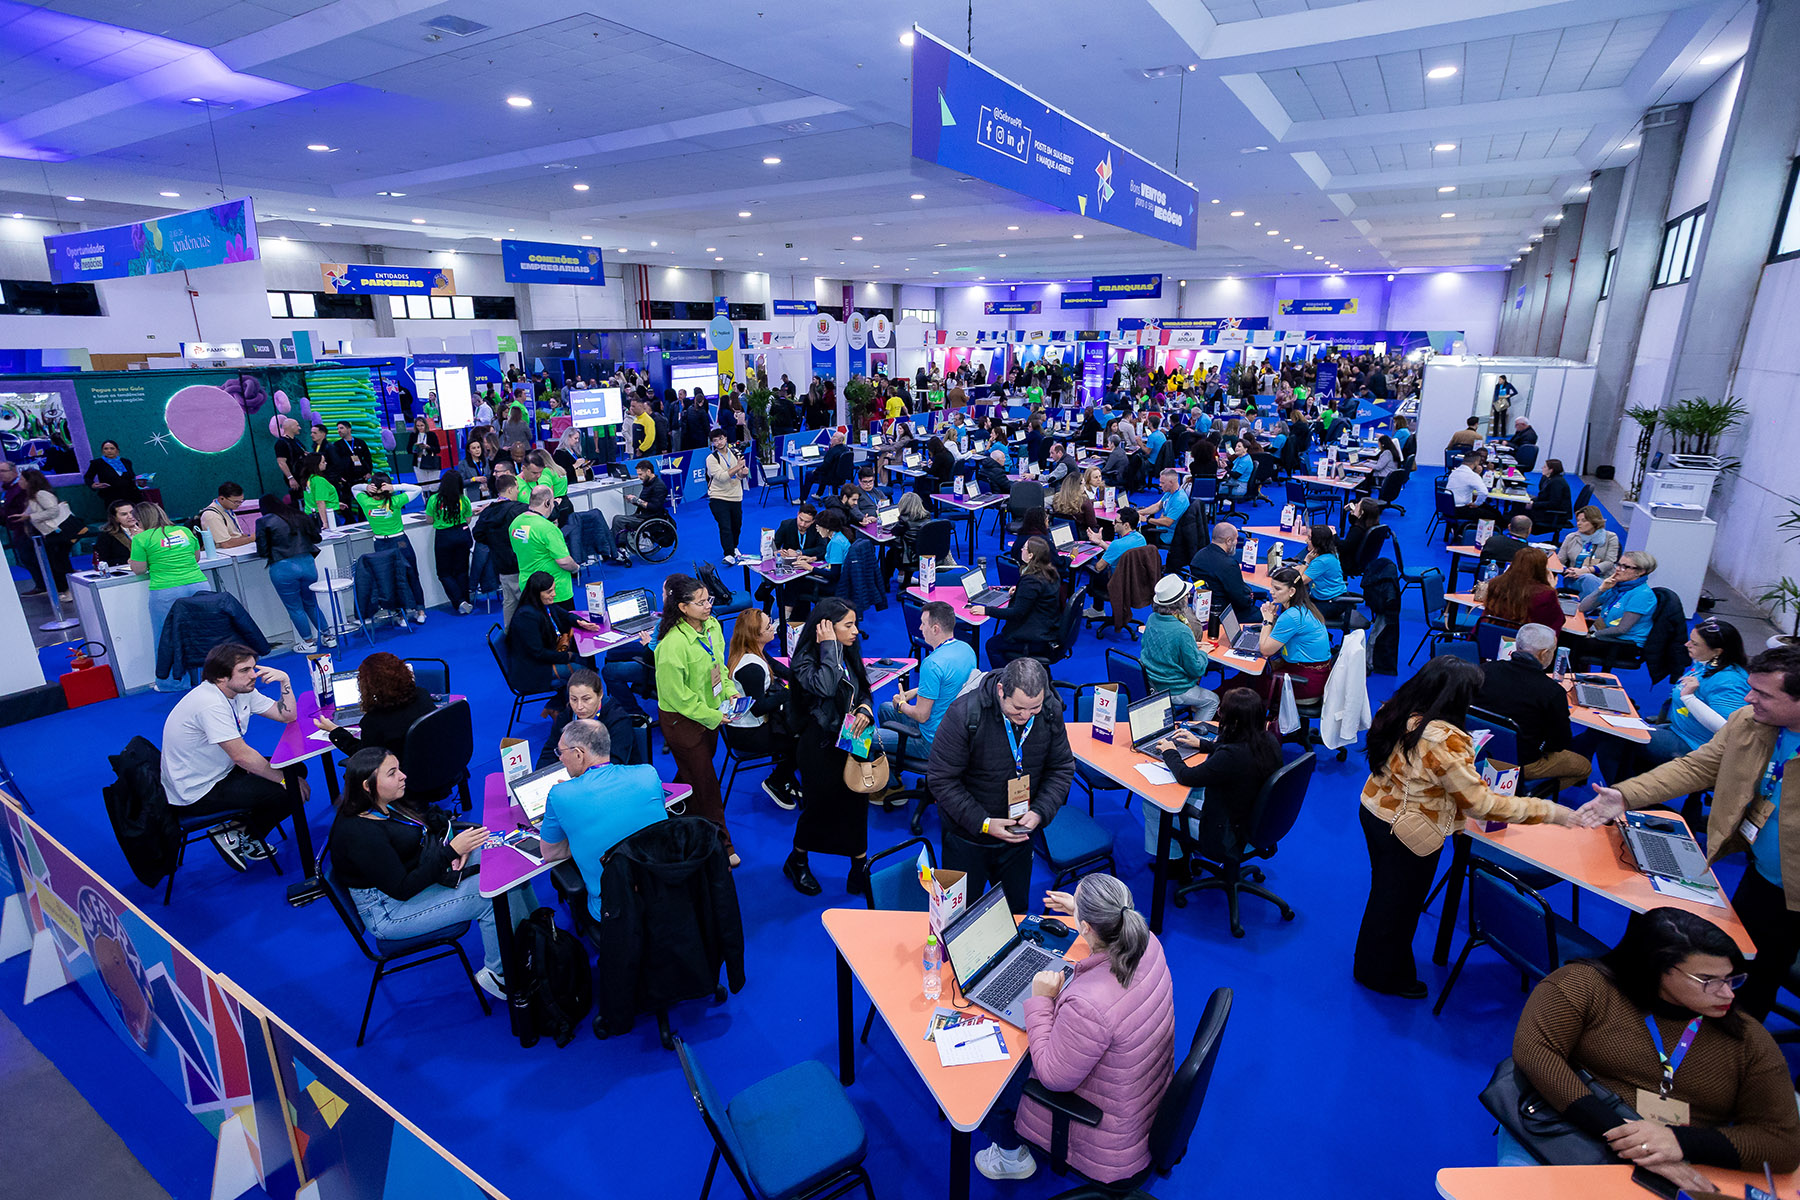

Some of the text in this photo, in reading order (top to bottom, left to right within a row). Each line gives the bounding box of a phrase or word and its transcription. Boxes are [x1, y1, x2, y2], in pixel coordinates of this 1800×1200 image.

[993, 107, 1022, 129] @SebraePR
[1034, 139, 1047, 154] POSTE
[1053, 148, 1063, 161] SUAS
[1062, 153, 1075, 166] REDES
[1039, 156, 1056, 170] MARQUE
[1130, 179, 1167, 206] Bons VENTOS
[1135, 196, 1145, 208] para
[1154, 206, 1183, 227] NEGÓCIO
[173, 233, 211, 253] tendências
[66, 244, 106, 259] Oportunidades
[74, 257, 103, 270] de negócios
[528, 254, 580, 265] CONEXÕES
[520, 262, 590, 273] EMPRESARIAIS
[361, 278, 424, 288] PARCEIRAS
[1099, 284, 1155, 292] FRANQUIAS
[1329, 336, 1357, 345] Rodadas
[573, 408, 591, 416] MESA
[1099, 698, 1110, 707] 37
[510, 754, 523, 766] 21
[1500, 781, 1513, 790] 40
[951, 892, 963, 909] 38
